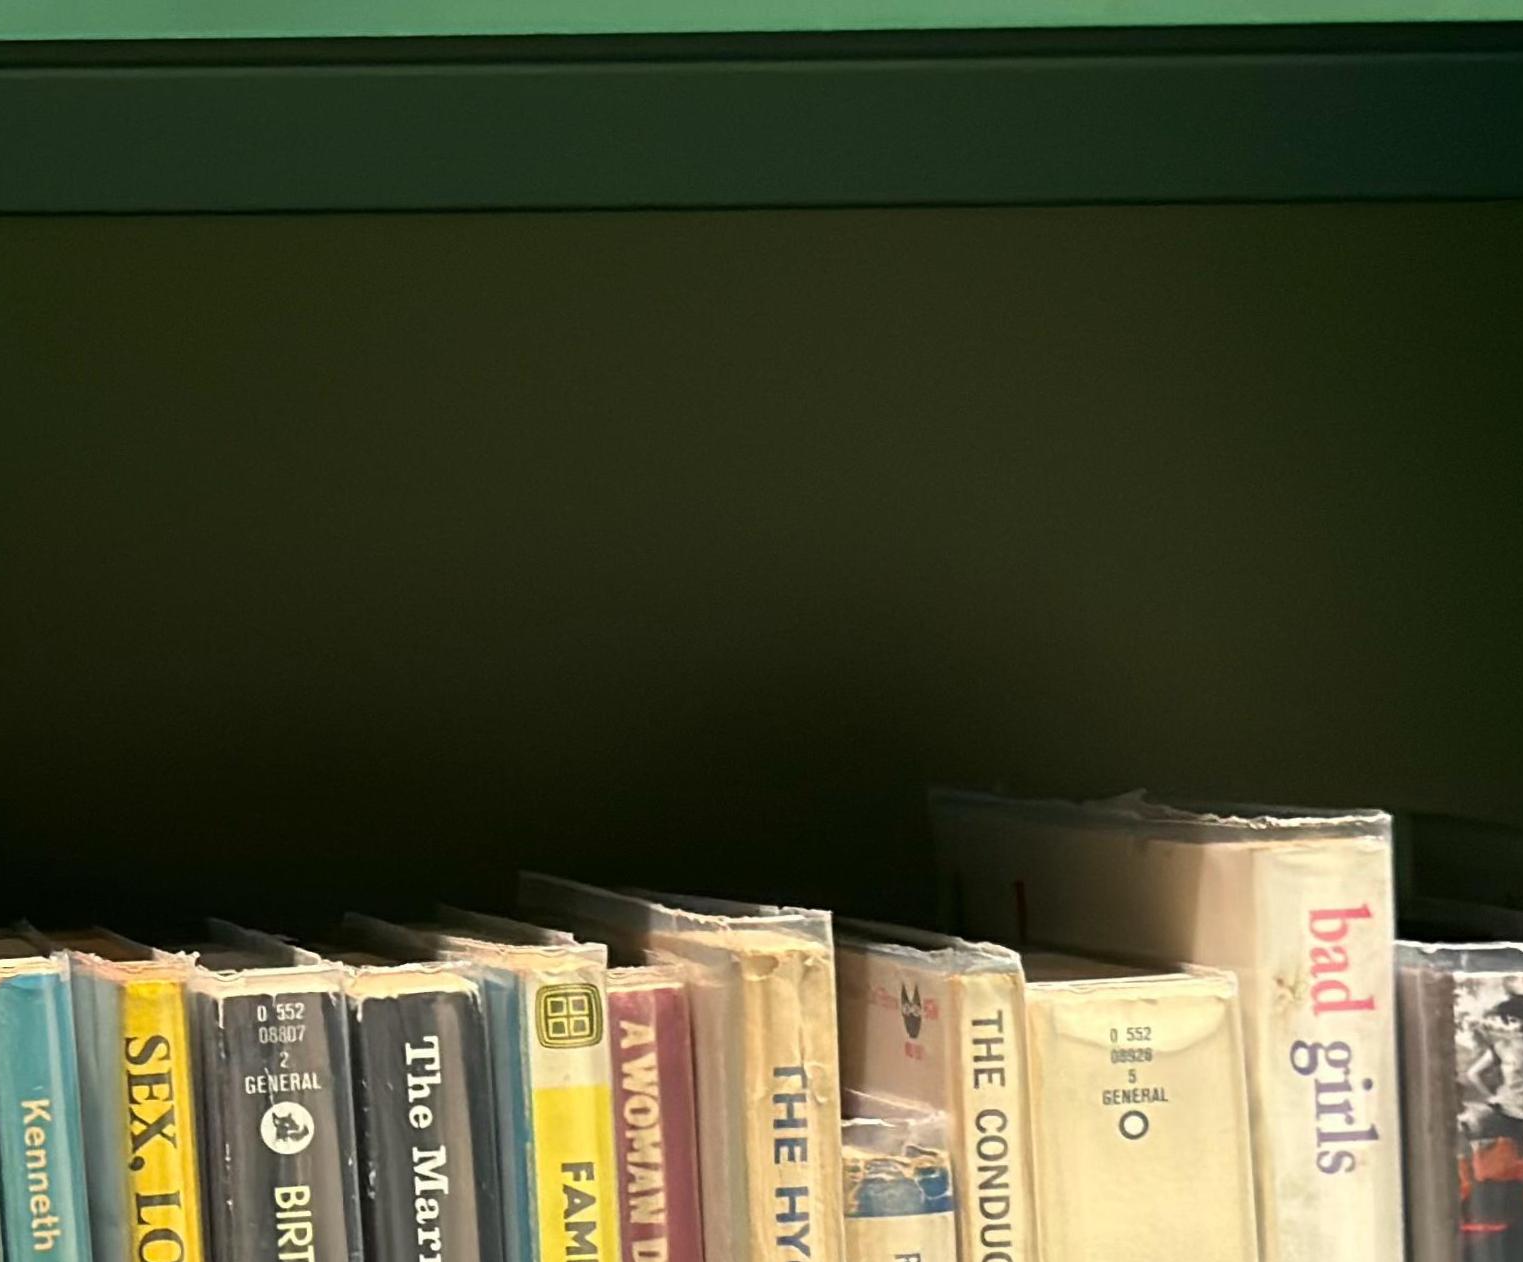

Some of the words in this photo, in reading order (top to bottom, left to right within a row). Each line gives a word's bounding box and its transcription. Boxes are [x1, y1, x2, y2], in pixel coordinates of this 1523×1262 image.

[1308, 904, 1375, 1017] bad
[125, 1034, 178, 1172] SEX,
[244, 1072, 322, 1094] GENERAL
[773, 1066, 806, 1162] THE
[1290, 1036, 1380, 1175] girls
[20, 1098, 56, 1251] Kenneth
